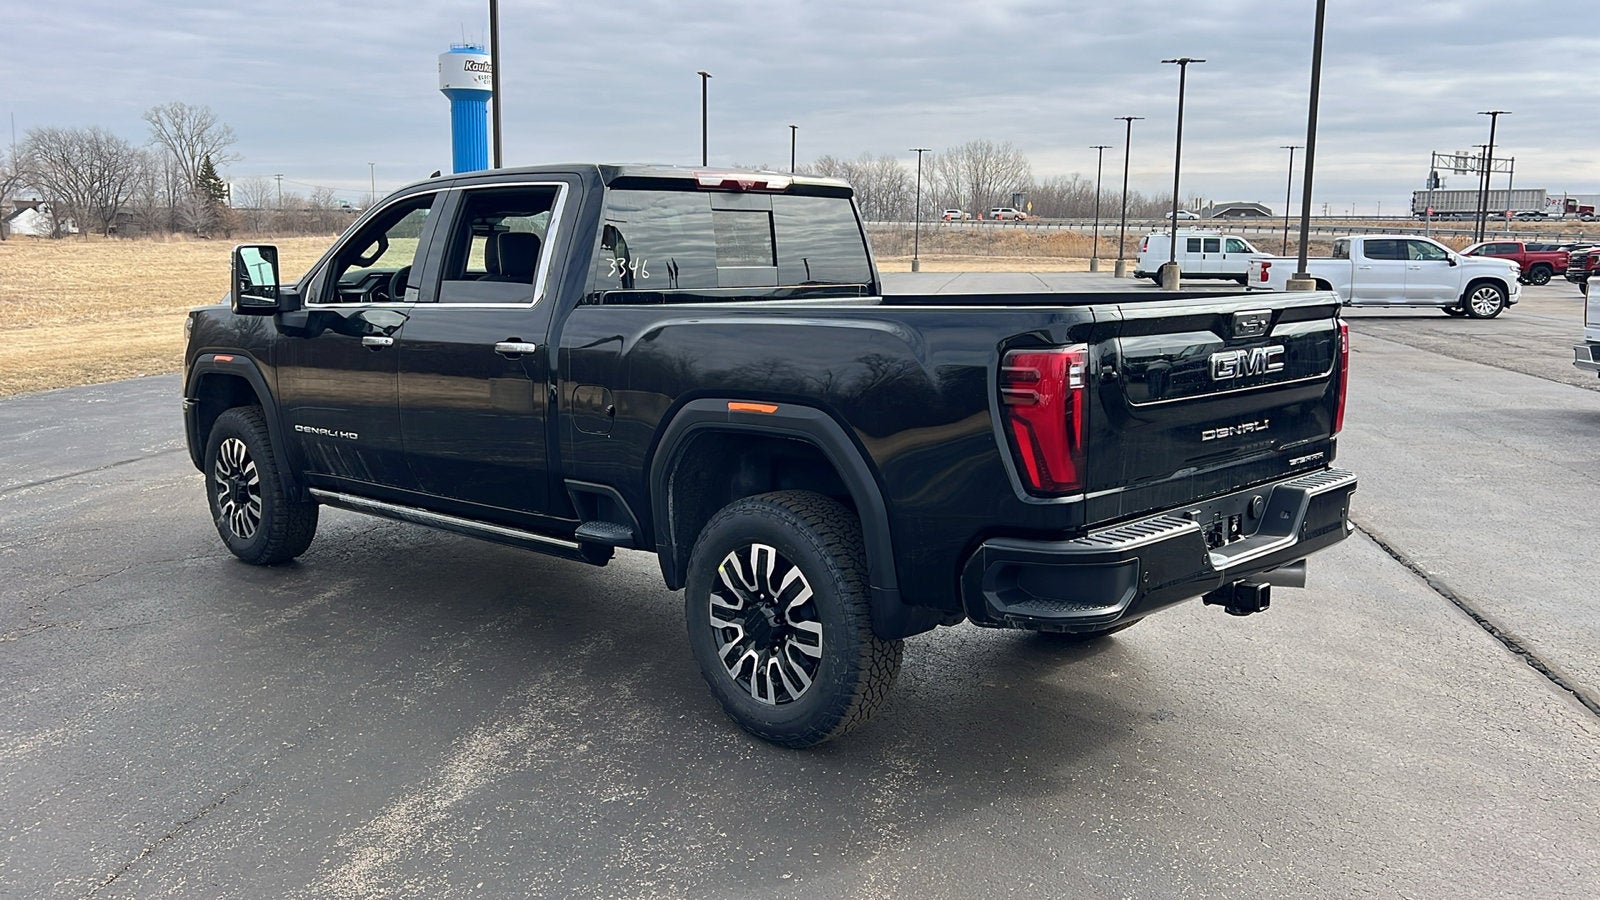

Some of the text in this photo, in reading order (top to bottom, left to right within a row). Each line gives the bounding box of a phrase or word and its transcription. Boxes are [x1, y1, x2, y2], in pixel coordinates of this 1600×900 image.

[606, 257, 650, 279] 3346
[1207, 345, 1285, 381] GMC
[294, 424, 359, 440] DENALI HD
[1202, 419, 1270, 441] DENALI
